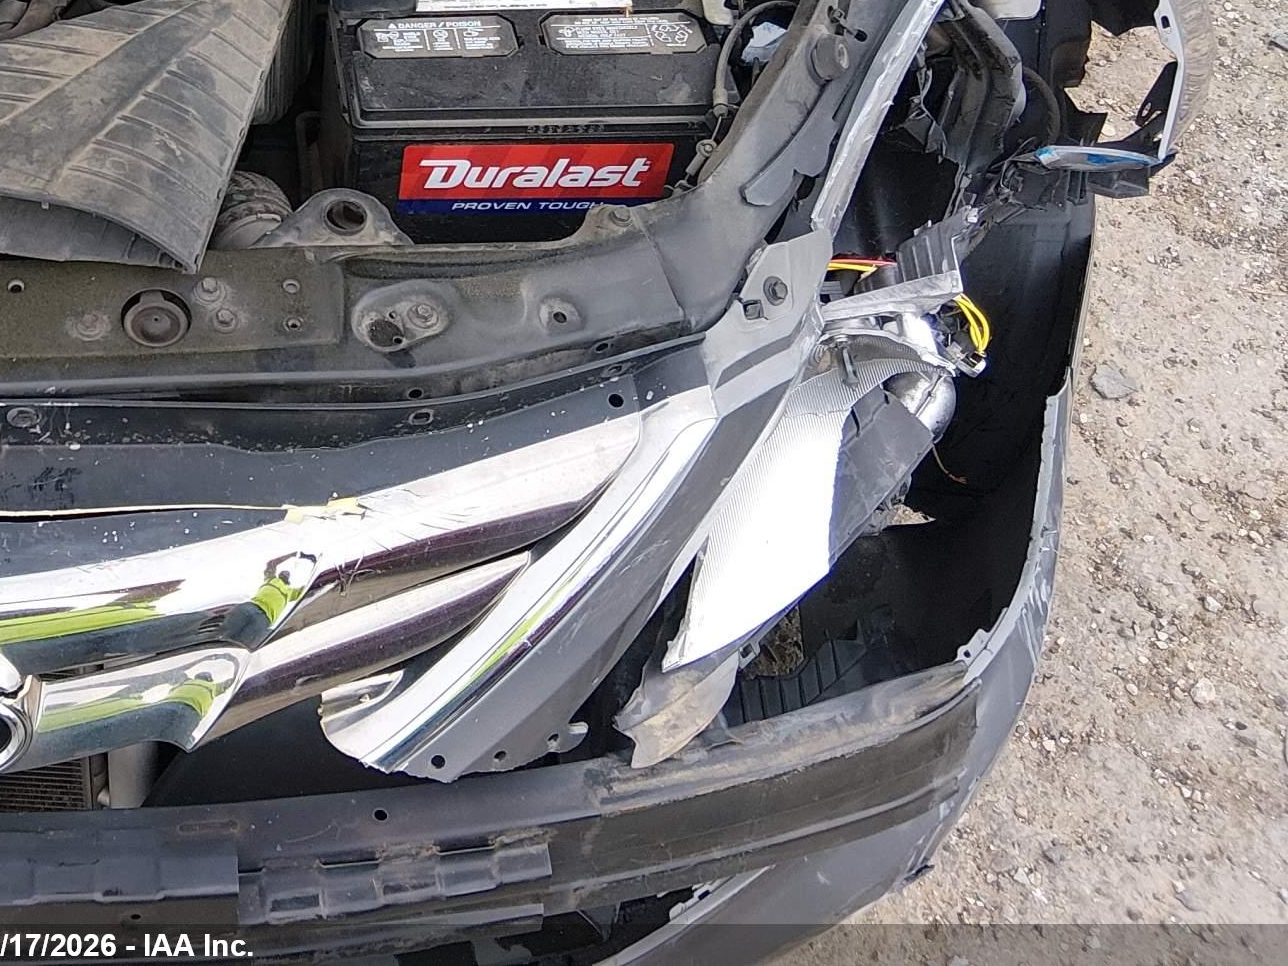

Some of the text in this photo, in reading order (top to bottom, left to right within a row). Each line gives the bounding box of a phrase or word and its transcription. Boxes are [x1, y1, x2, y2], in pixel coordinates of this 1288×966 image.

[398, 21, 436, 29] DANGER
[445, 20, 481, 28] POISON
[419, 157, 651, 189] Duralast
[452, 201, 531, 210] PROVEN
